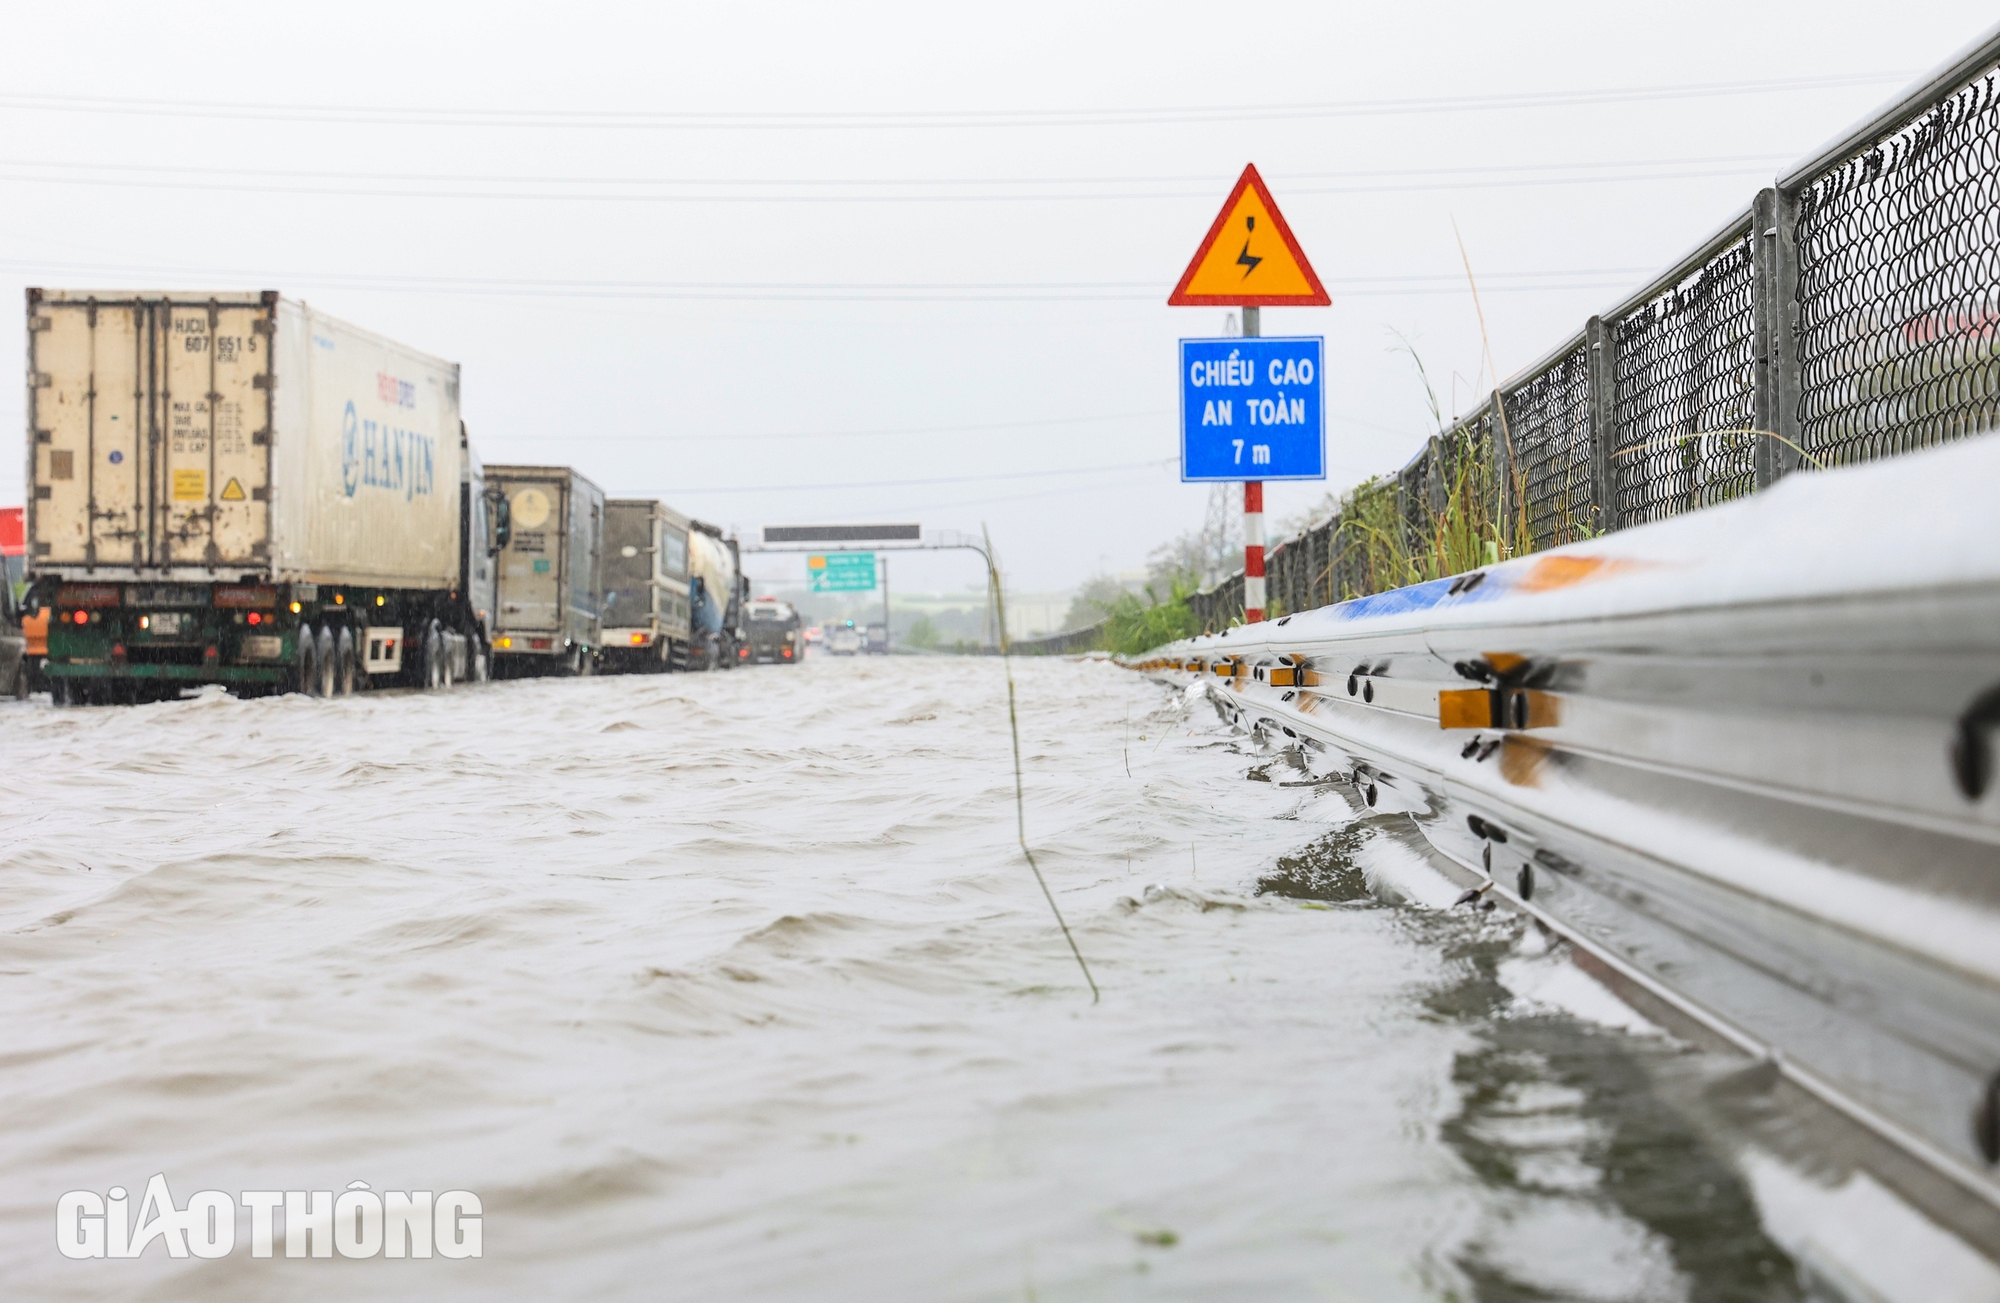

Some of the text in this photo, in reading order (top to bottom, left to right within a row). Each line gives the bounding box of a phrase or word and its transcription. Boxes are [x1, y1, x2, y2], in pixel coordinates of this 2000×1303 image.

[175, 318, 206, 333] HJCU
[185, 336, 209, 352] 607
[1190, 348, 1314, 387] CHIỀU CAO
[1201, 390, 1305, 426] AN TOÀN
[363, 418, 434, 503] HANJIN
[1232, 439, 1270, 465] 7 m
